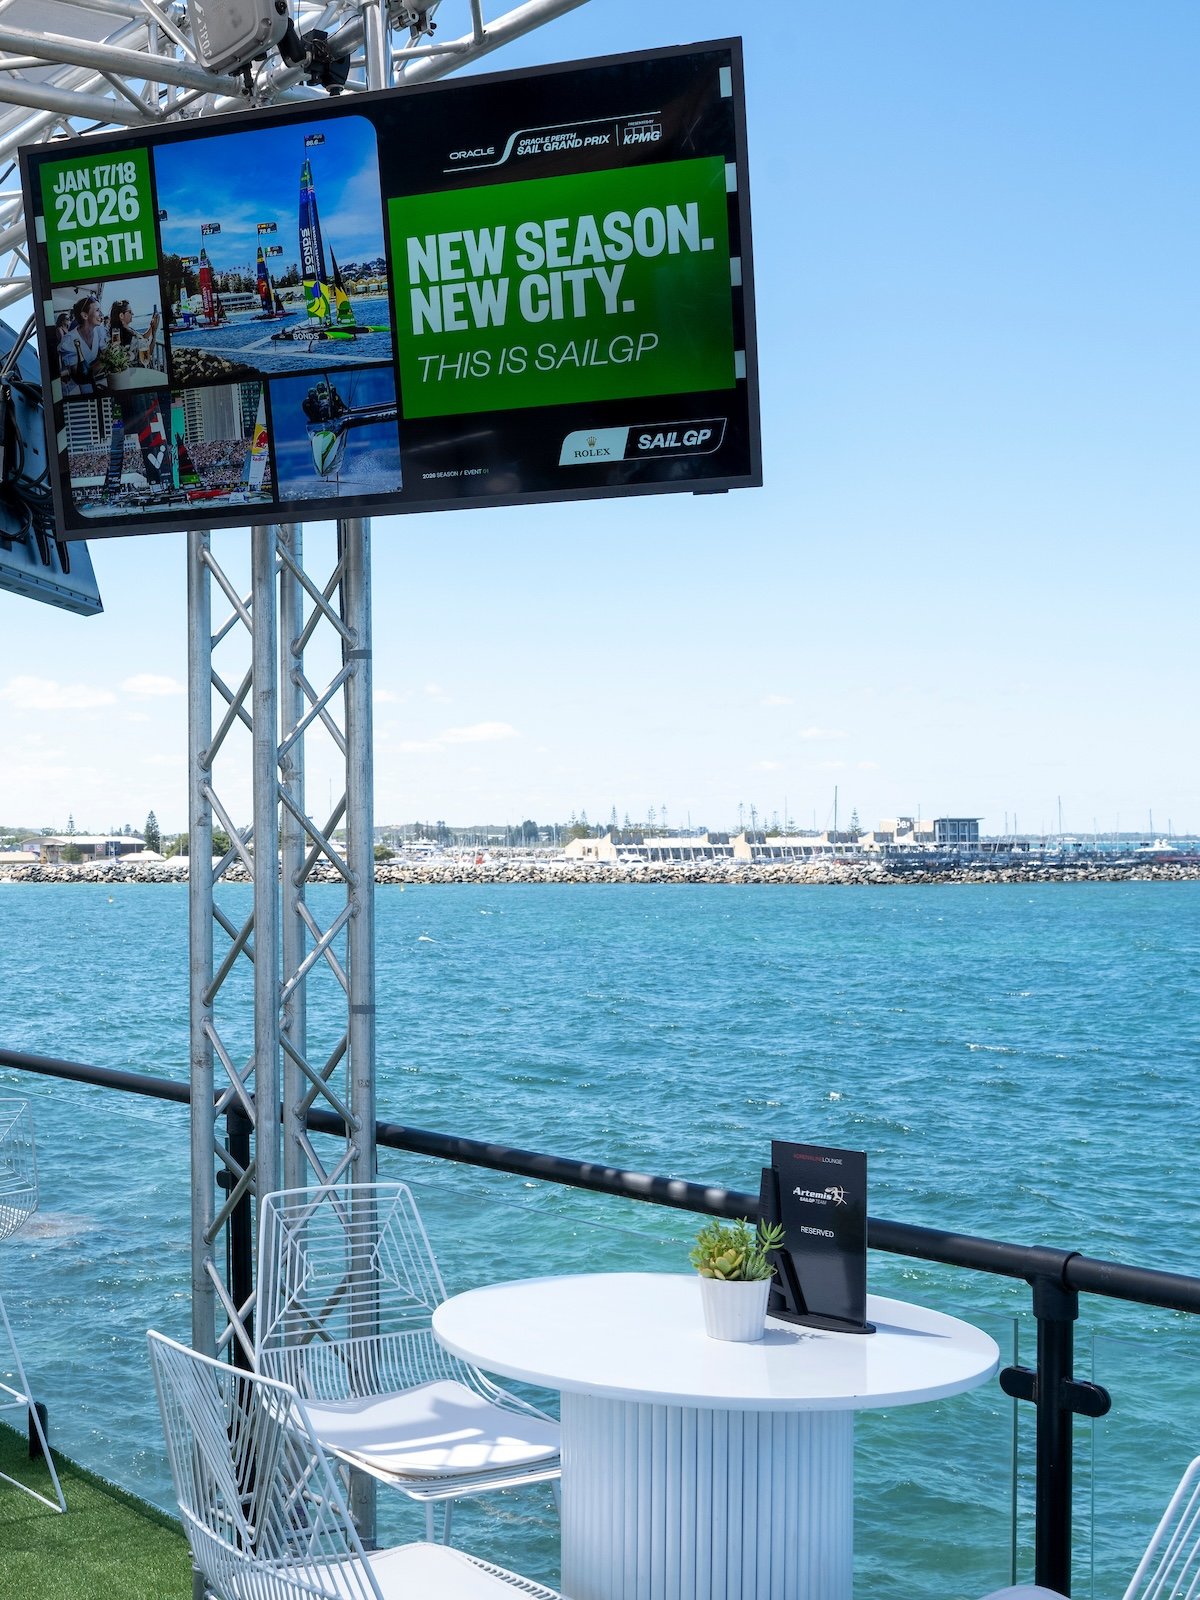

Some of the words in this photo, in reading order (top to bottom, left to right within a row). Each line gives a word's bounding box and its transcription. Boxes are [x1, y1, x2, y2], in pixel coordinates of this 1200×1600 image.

[516, 144, 542, 156] SAIL
[543, 138, 582, 152] GRAND
[584, 134, 611, 147] PRIX
[519, 136, 550, 147] ORACLE
[551, 132, 577, 143] PERTH
[623, 131, 660, 145] KPMG
[449, 146, 495, 160] ORACLE
[53, 168, 90, 194] JAN
[93, 161, 137, 188] 17/18
[55, 184, 140, 231] 2026
[60, 230, 144, 270] PERTH
[301, 227, 314, 275] BONDS
[406, 225, 506, 284] NEW
[515, 202, 714, 271] SEASON.
[410, 277, 509, 336] NEW
[518, 264, 635, 323] CITY.
[293, 332, 319, 340] BONDS
[417, 349, 492, 382] THIS
[498, 346, 528, 375] IS
[535, 333, 659, 371] SAILGP
[574, 448, 611, 458] ROLEX
[793, 1187, 832, 1201] Artemis
[800, 1225, 834, 1238] RESERVED
